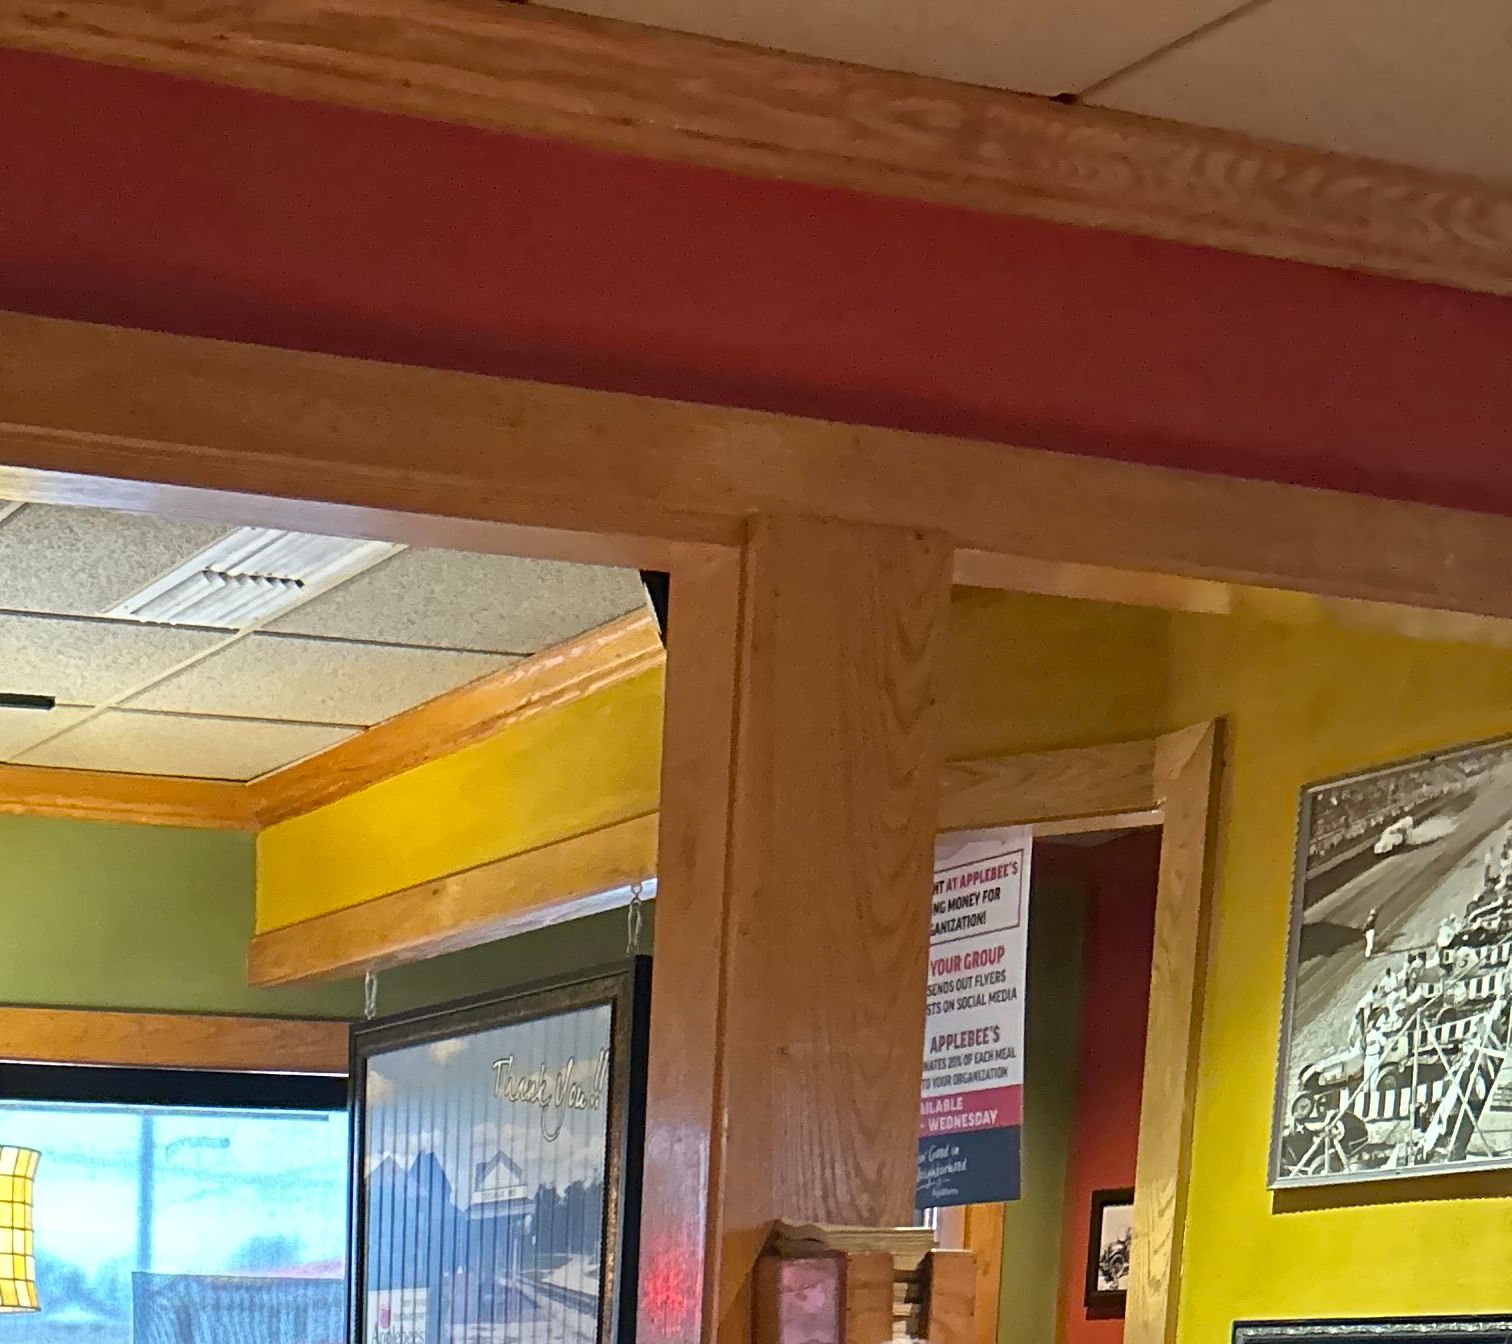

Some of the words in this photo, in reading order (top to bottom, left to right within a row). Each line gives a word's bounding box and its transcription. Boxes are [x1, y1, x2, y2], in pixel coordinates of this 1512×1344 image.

[960, 860, 1018, 889] APPLEBEE'S
[948, 892, 981, 912] MONEY
[983, 887, 1001, 905] FOR
[931, 955, 962, 977] YOUR
[964, 945, 1005, 970] GROUP
[927, 981, 954, 997] SENDS
[956, 976, 972, 991] OUT
[975, 969, 1006, 987] FLYERS
[943, 999, 955, 1013] ON
[957, 993, 986, 1010] SOCIAL
[989, 987, 1017, 1004] MEDIA
[930, 1024, 1000, 1054] APPLEBEE'S
[974, 1049, 994, 1065] EACH
[996, 1047, 1016, 1061] MEAL
[492, 1053, 552, 1108] Thank
[953, 1066, 1008, 1086] ORGANIZATION
[928, 1109, 999, 1132] WEDNESDAY
